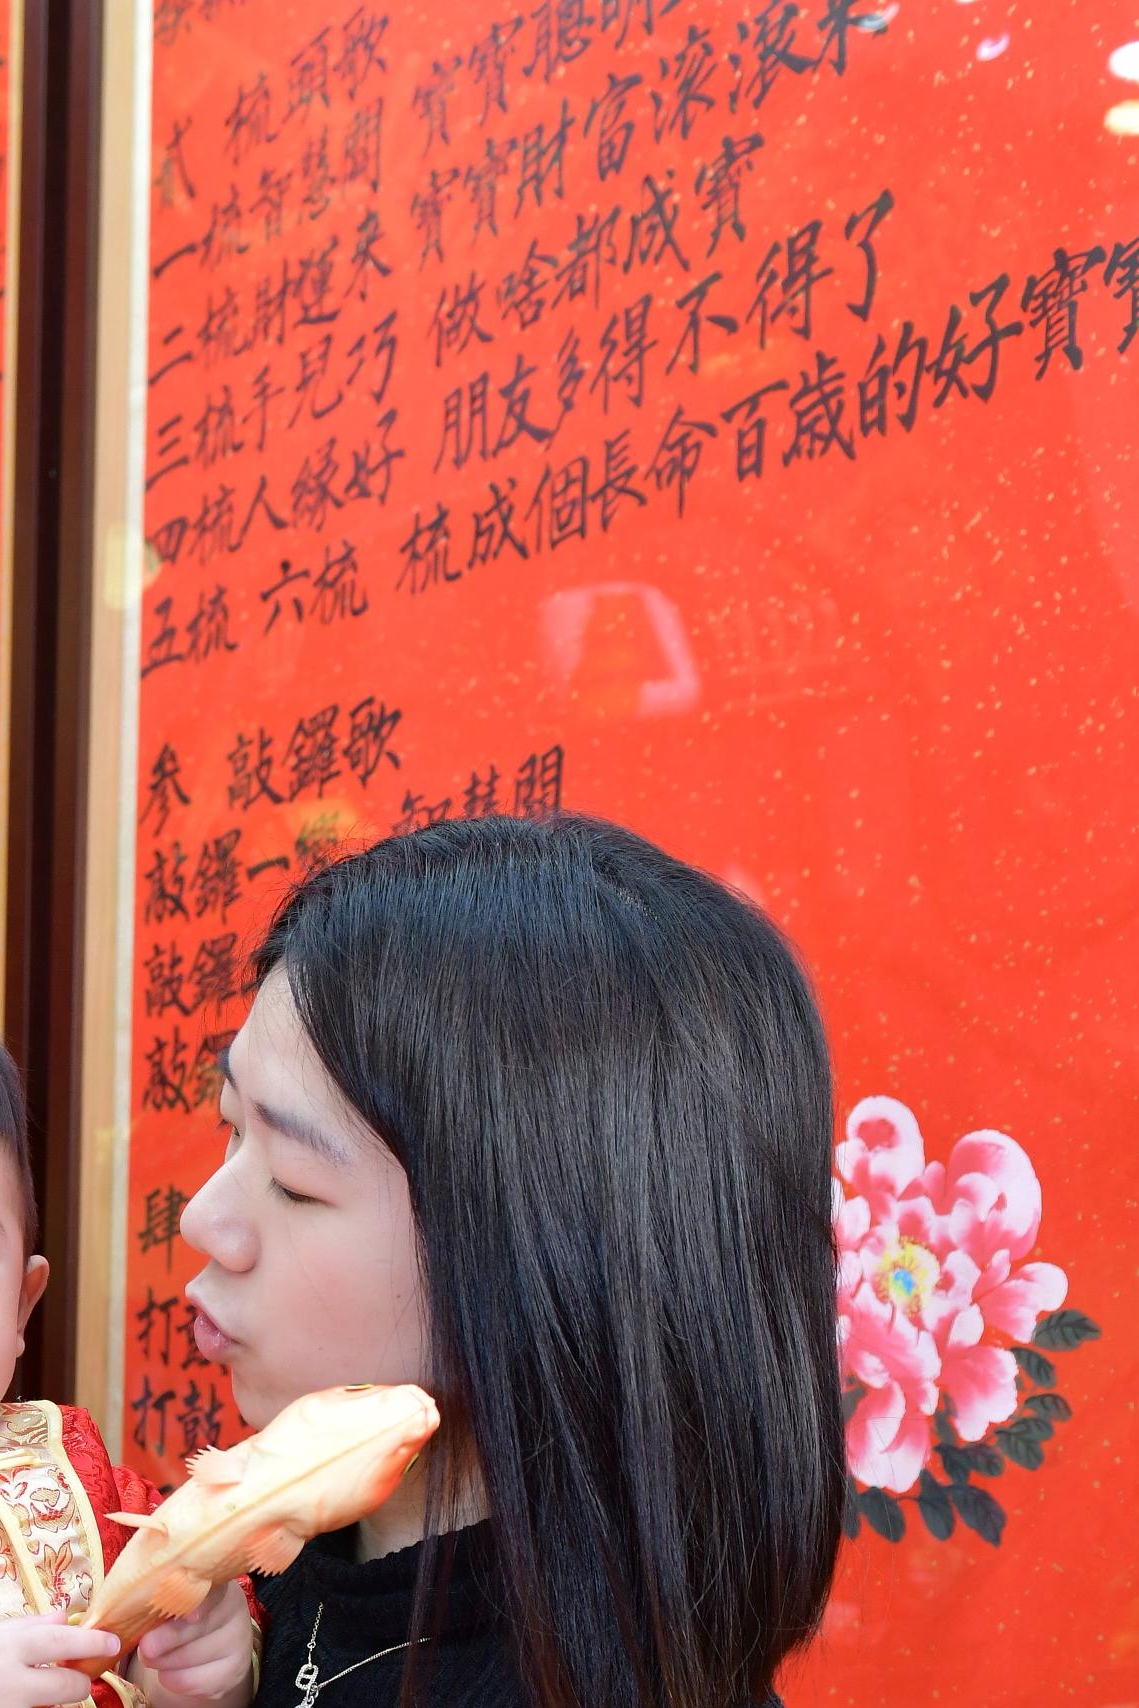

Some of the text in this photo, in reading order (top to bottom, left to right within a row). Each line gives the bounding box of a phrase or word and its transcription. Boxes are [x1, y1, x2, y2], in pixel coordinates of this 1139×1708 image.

[412, 0, 681, 158] 寶寶聰明
[143, 408, 405, 570] 四梳人緣好
[434, 188, 895, 474] 朋友多得不得了
[139, 584, 239, 679] 五梳
[261, 538, 369, 636] 六梳
[226, 696, 403, 812] 敲鑼歌
[143, 932, 260, 1020] 敲鑼
[131, 1375, 248, 1459] 打鼓
